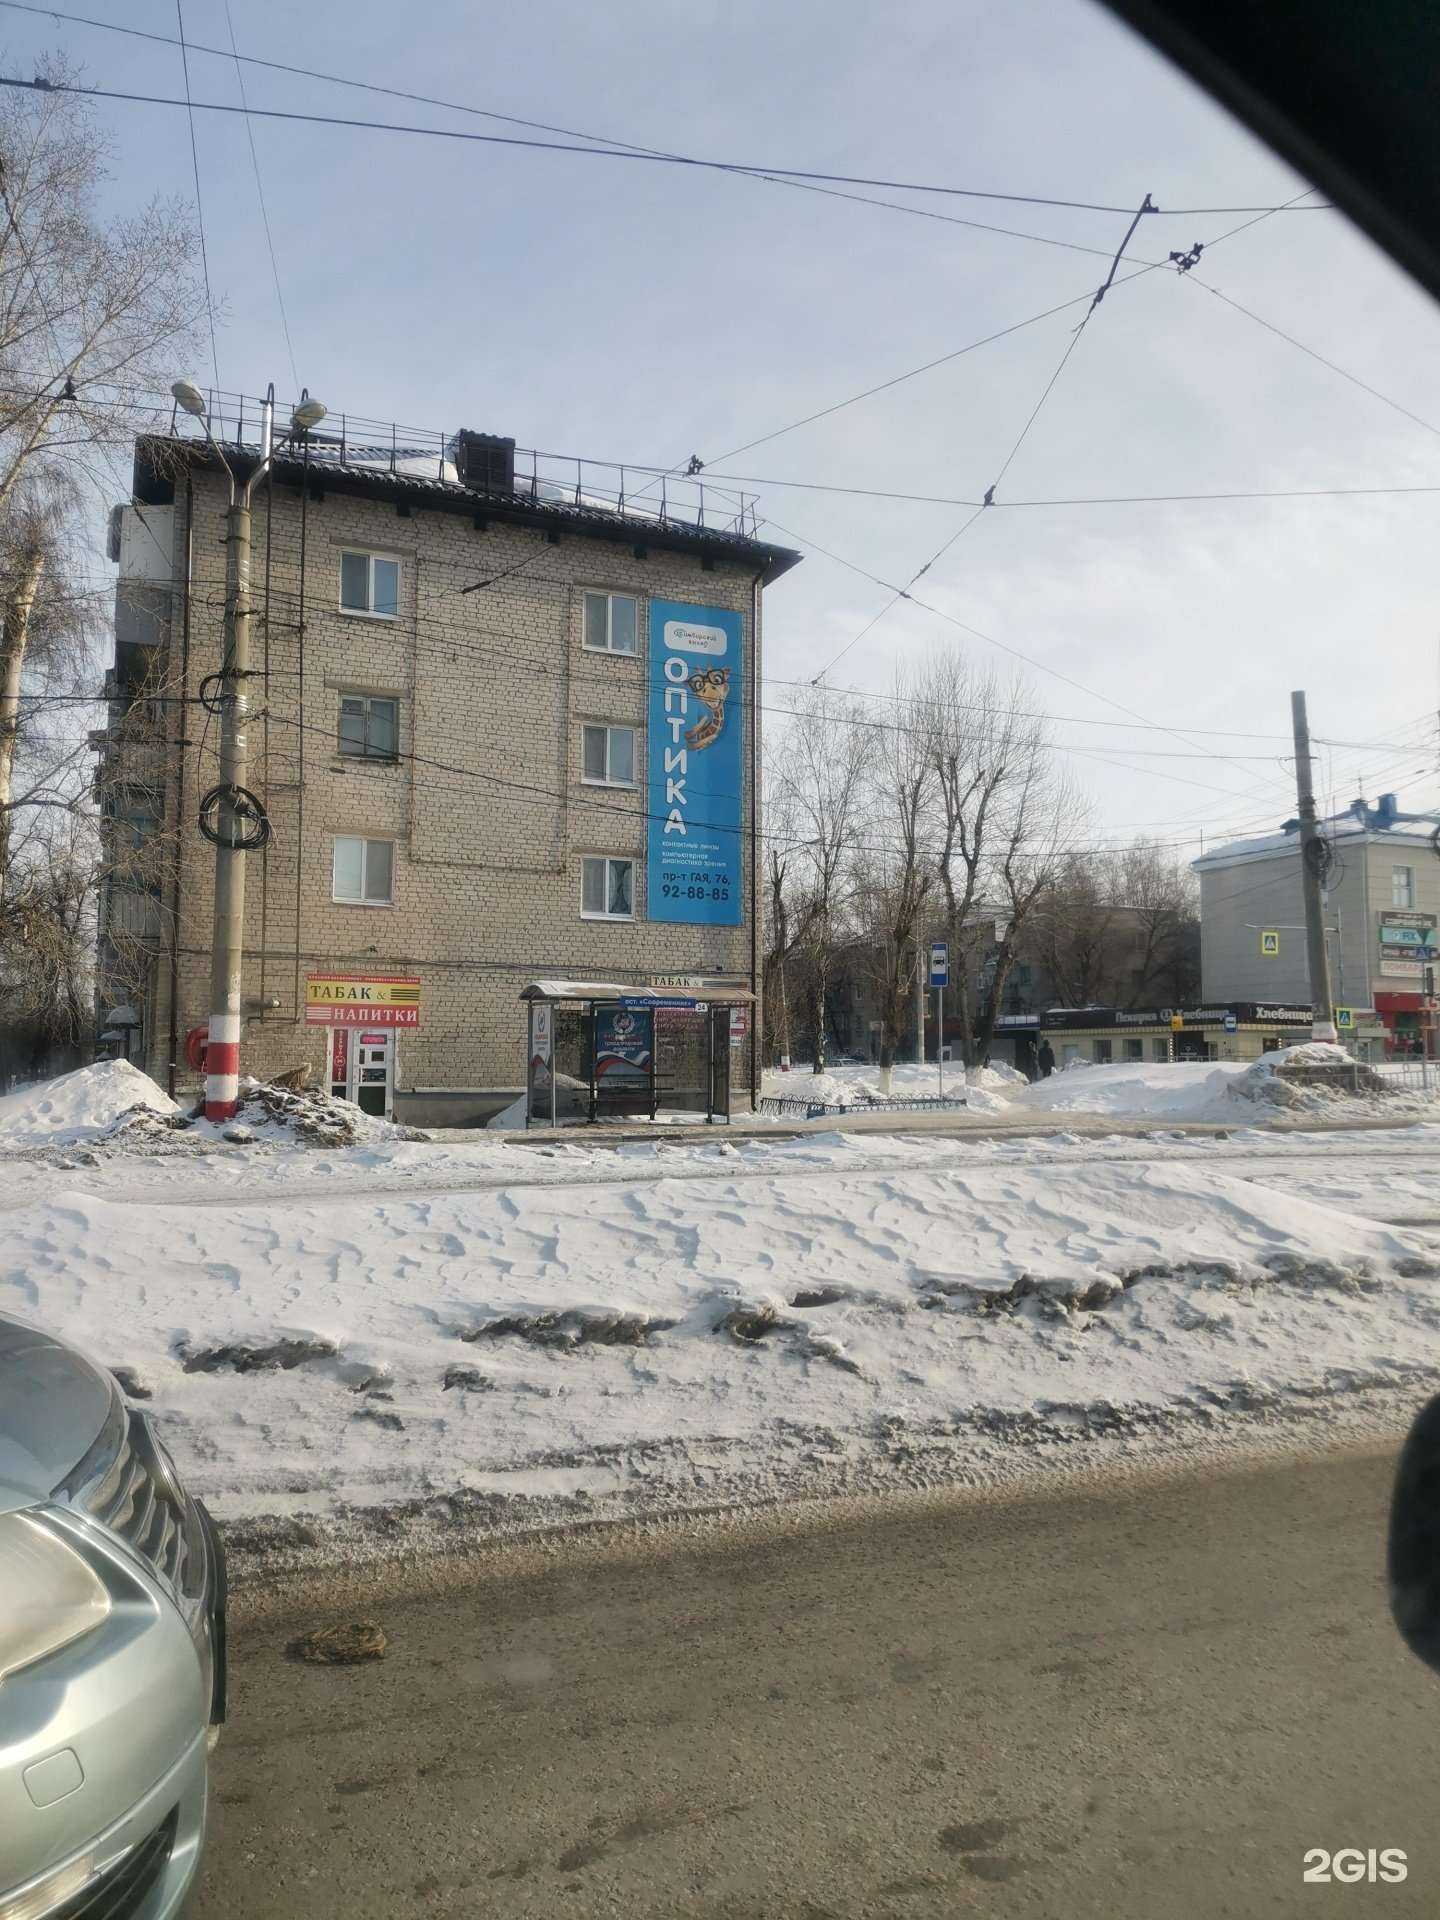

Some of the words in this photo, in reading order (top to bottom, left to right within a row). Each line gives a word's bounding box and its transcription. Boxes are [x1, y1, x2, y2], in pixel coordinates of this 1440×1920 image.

[664, 657, 688, 835] ОПТИКА
[661, 858, 702, 866] диагностика
[662, 872, 687, 882] пр-т
[690, 872, 711, 884] ГАЯ,
[715, 873, 730, 886] 76,
[662, 884, 729, 901] 92-88-85
[653, 976, 690, 987] ТАБАК
[310, 985, 372, 1000] ТАБАК
[376, 992, 387, 1000] &
[334, 1008, 418, 1022] НАПИТКИ
[1255, 1006, 1312, 1023] Хлебница
